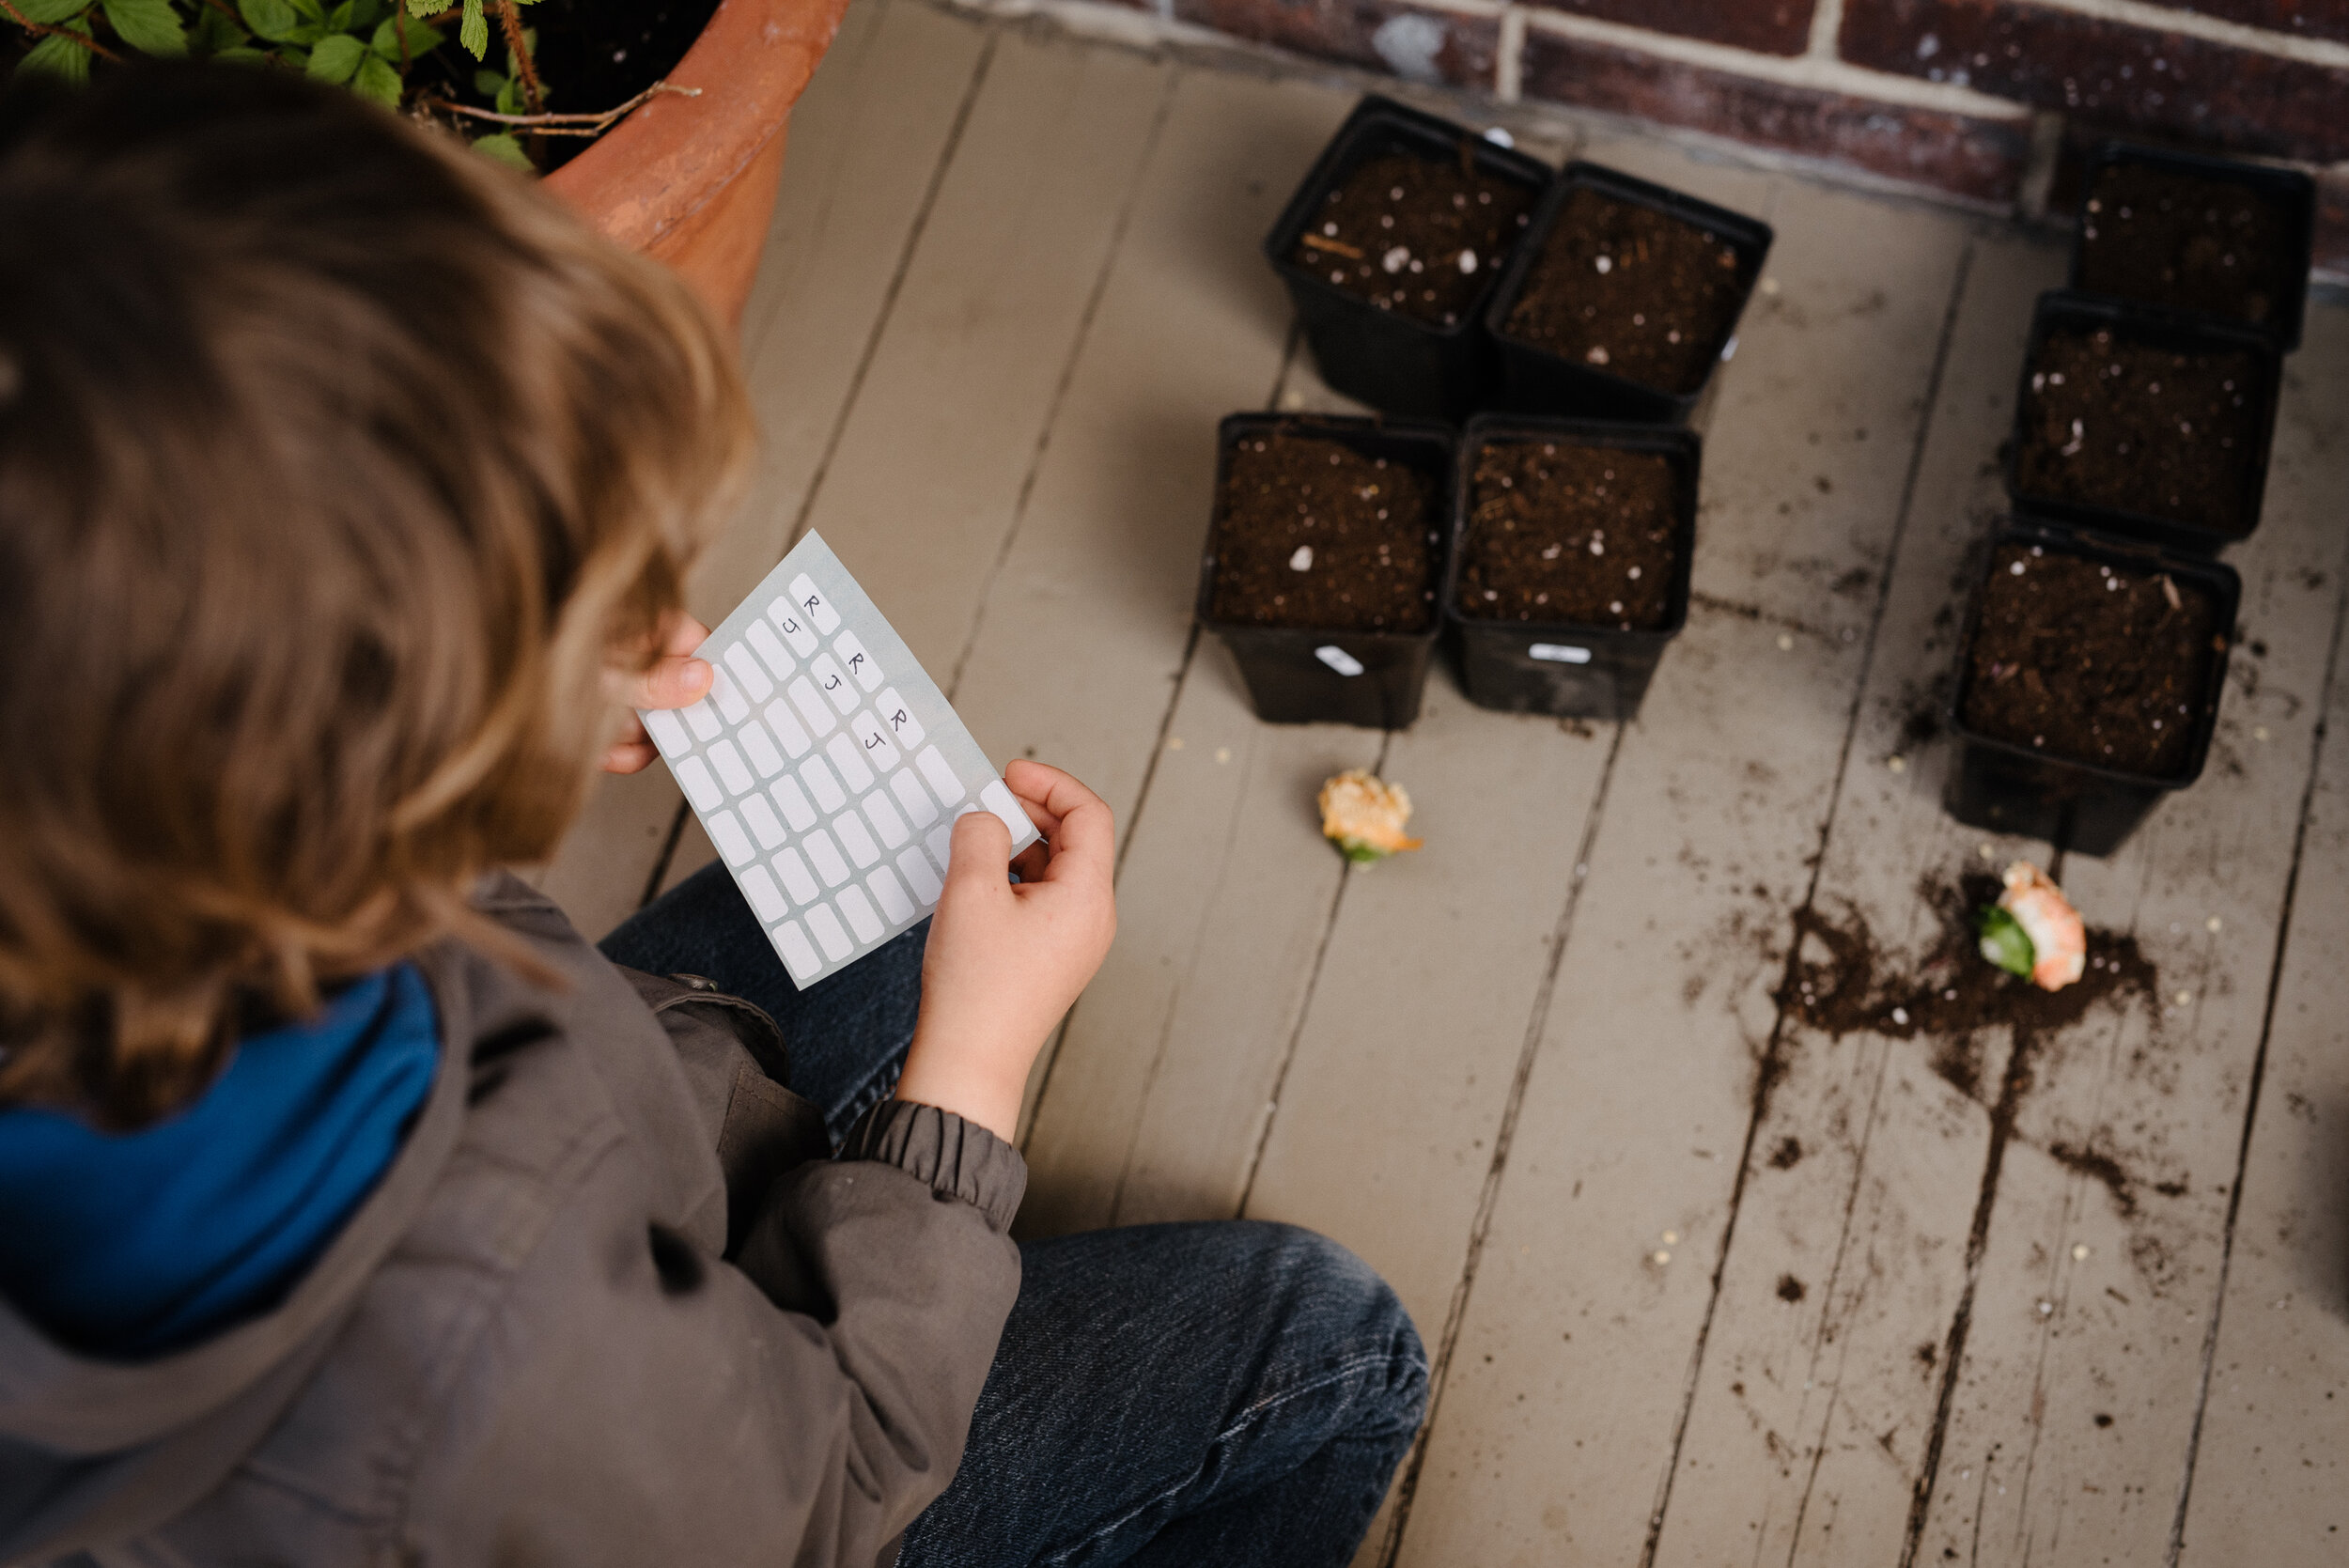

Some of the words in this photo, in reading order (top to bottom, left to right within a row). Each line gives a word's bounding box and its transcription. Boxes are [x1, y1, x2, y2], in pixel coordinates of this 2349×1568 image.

[804, 596, 819, 616] R
[849, 653, 863, 675] R
[891, 709, 906, 731] R
